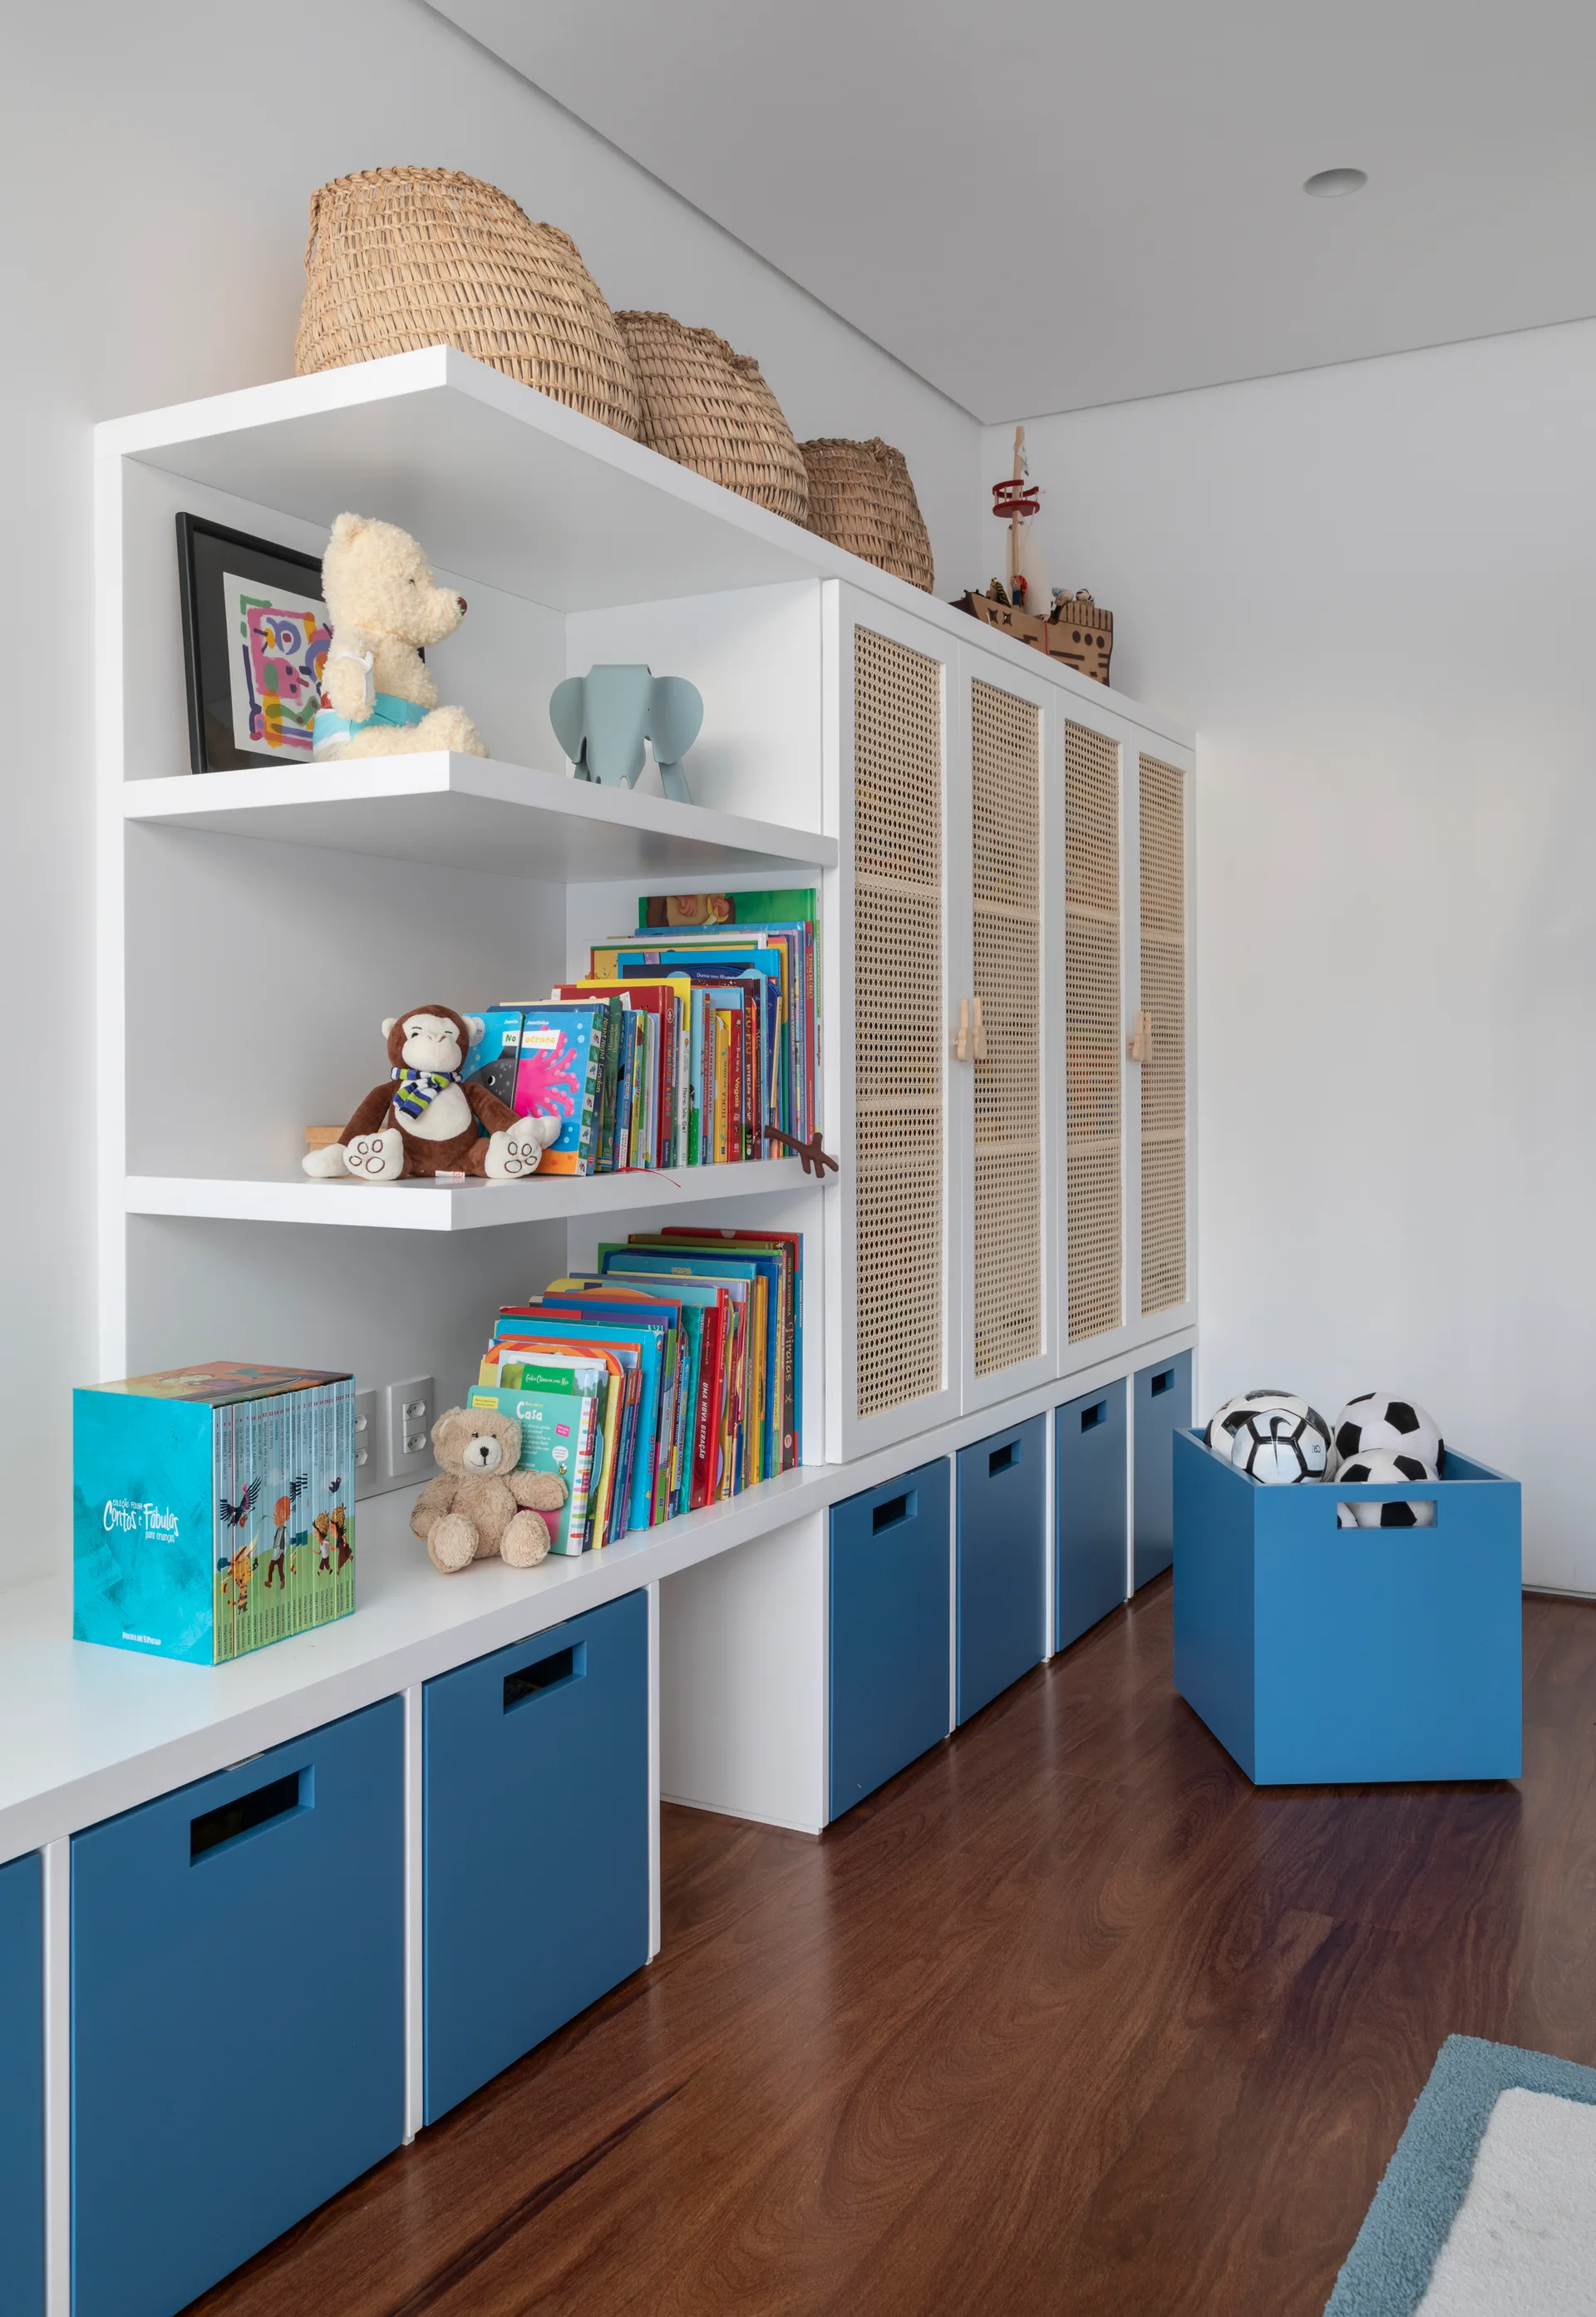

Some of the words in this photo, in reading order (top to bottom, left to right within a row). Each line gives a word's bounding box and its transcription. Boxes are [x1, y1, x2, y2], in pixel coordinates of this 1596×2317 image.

[600, 1017, 609, 1038] Night
[505, 1034, 517, 1043] No
[709, 1030, 714, 1043] NA
[598, 1039, 608, 1060] Night
[595, 1063, 604, 1093] London
[682, 1107, 688, 1119] We
[786, 1274, 791, 1284] DE
[784, 1322, 794, 1382] Piratas
[516, 1400, 543, 1422] Casa
[698, 1424, 707, 1460] GERAÇÃO
[112, 1498, 130, 1509] COLEÇÃO
[131, 1501, 144, 1510] FOLHA
[103, 1500, 137, 1532] Contos
[138, 1515, 142, 1526] e
[143, 1503, 180, 1536] Fábulas
[145, 1530, 155, 1541] para
[156, 1532, 175, 1544] crianças
[122, 1631, 137, 1641] FOLHA
